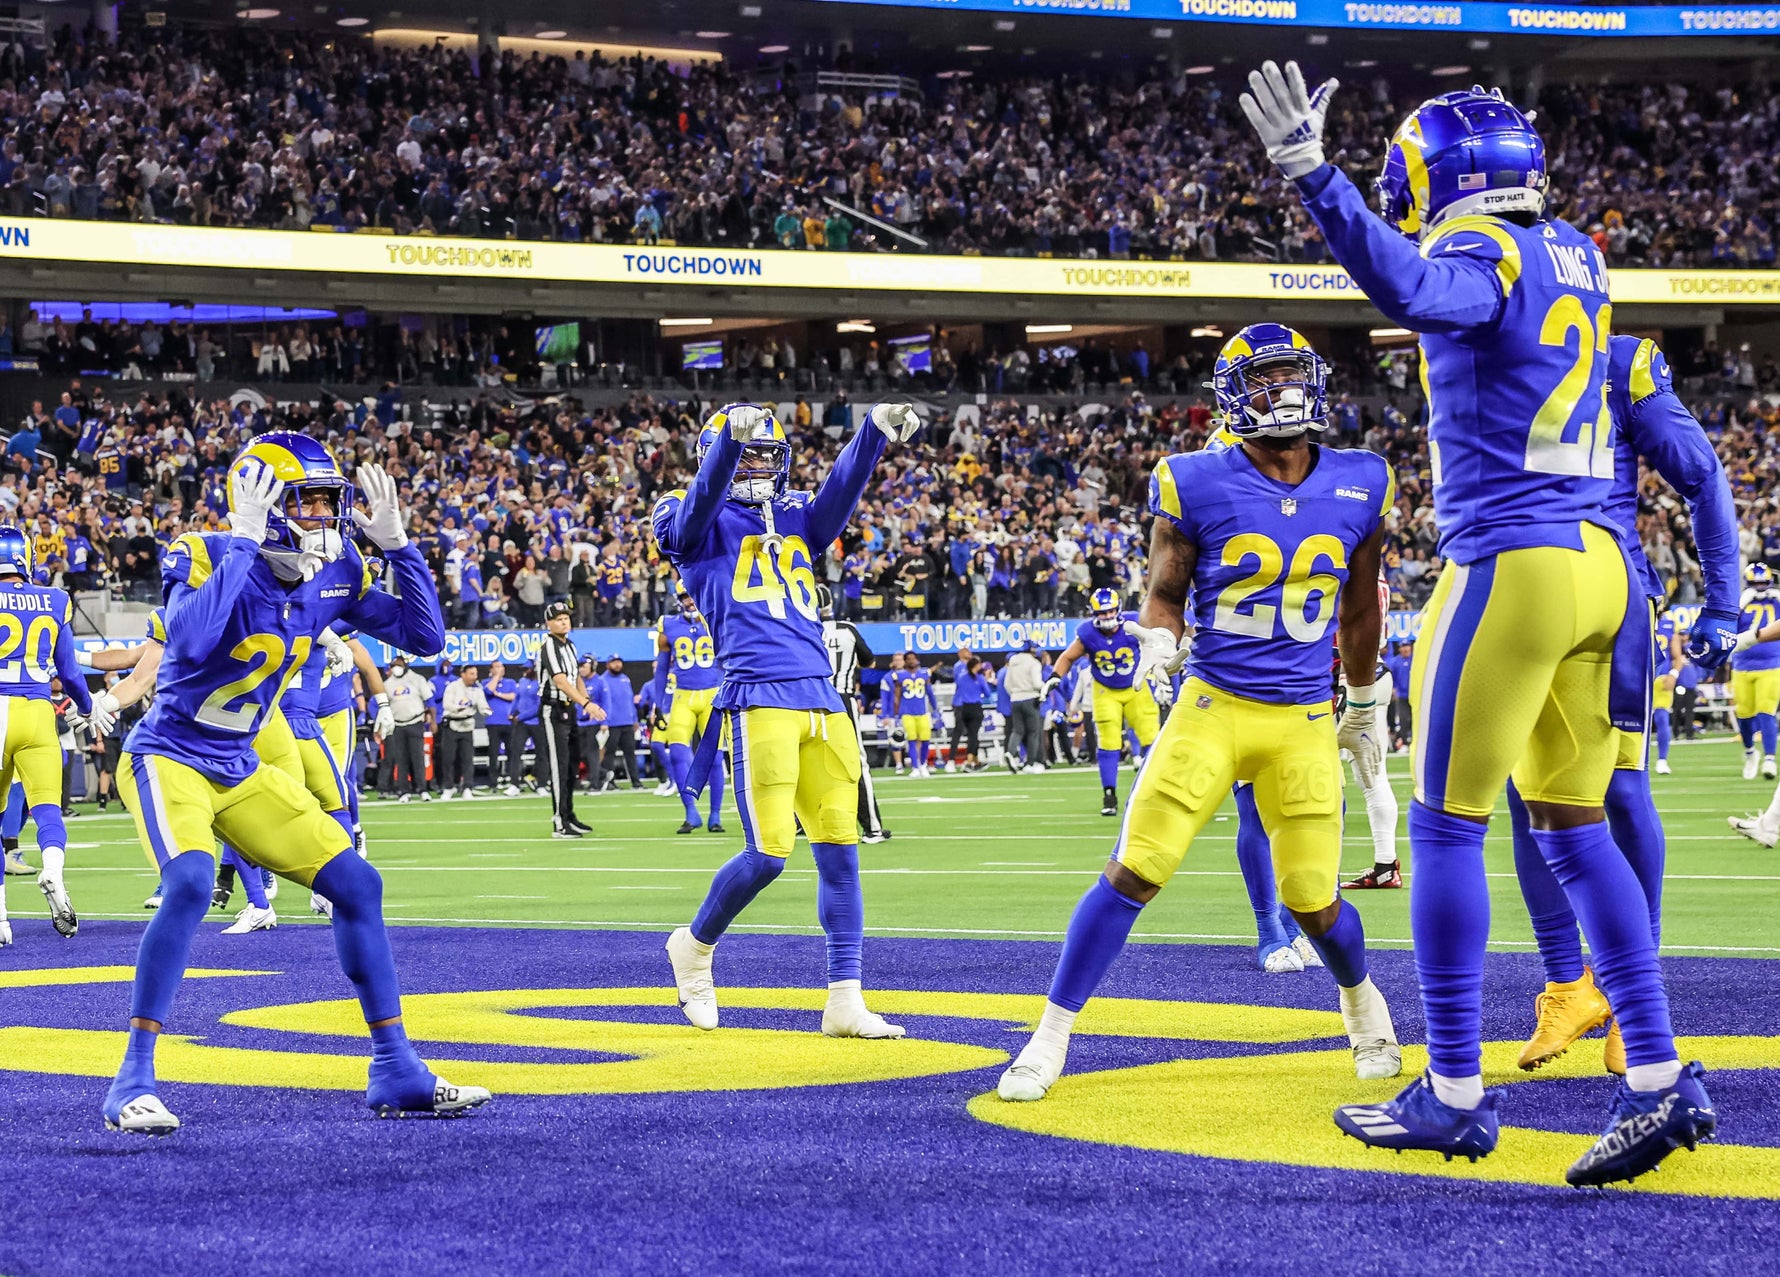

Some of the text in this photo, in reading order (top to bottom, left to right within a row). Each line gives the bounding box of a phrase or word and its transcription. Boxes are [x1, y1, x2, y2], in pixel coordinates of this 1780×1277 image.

[1179, 0, 1297, 19] TOUCHDOWN
[1344, 3, 1462, 25] TOUCHDOWN
[1508, 8, 1626, 30] TOUCHDOWN
[1680, 10, 1780, 30] TOUCHDO
[1484, 193, 1525, 204] STOP HATE
[386, 244, 762, 276] TOUCHDOWN TOUCHDOWN
[1593, 249, 1609, 294] J
[1062, 267, 1361, 290] TOUCHDOWN TOUCHDO
[1669, 278, 1780, 295] TOUCHDOW
[1336, 488, 1369, 501] RAMS
[731, 534, 818, 622] 46
[1213, 532, 1347, 643] 26
[320, 589, 350, 599] RAMS
[0, 612, 59, 684] 20
[378, 633, 550, 664] TCHDOW
[899, 622, 1068, 651] TOUCHDOWN
[674, 635, 715, 670] 86
[1094, 646, 1136, 678] 63
[194, 632, 312, 733] 21
